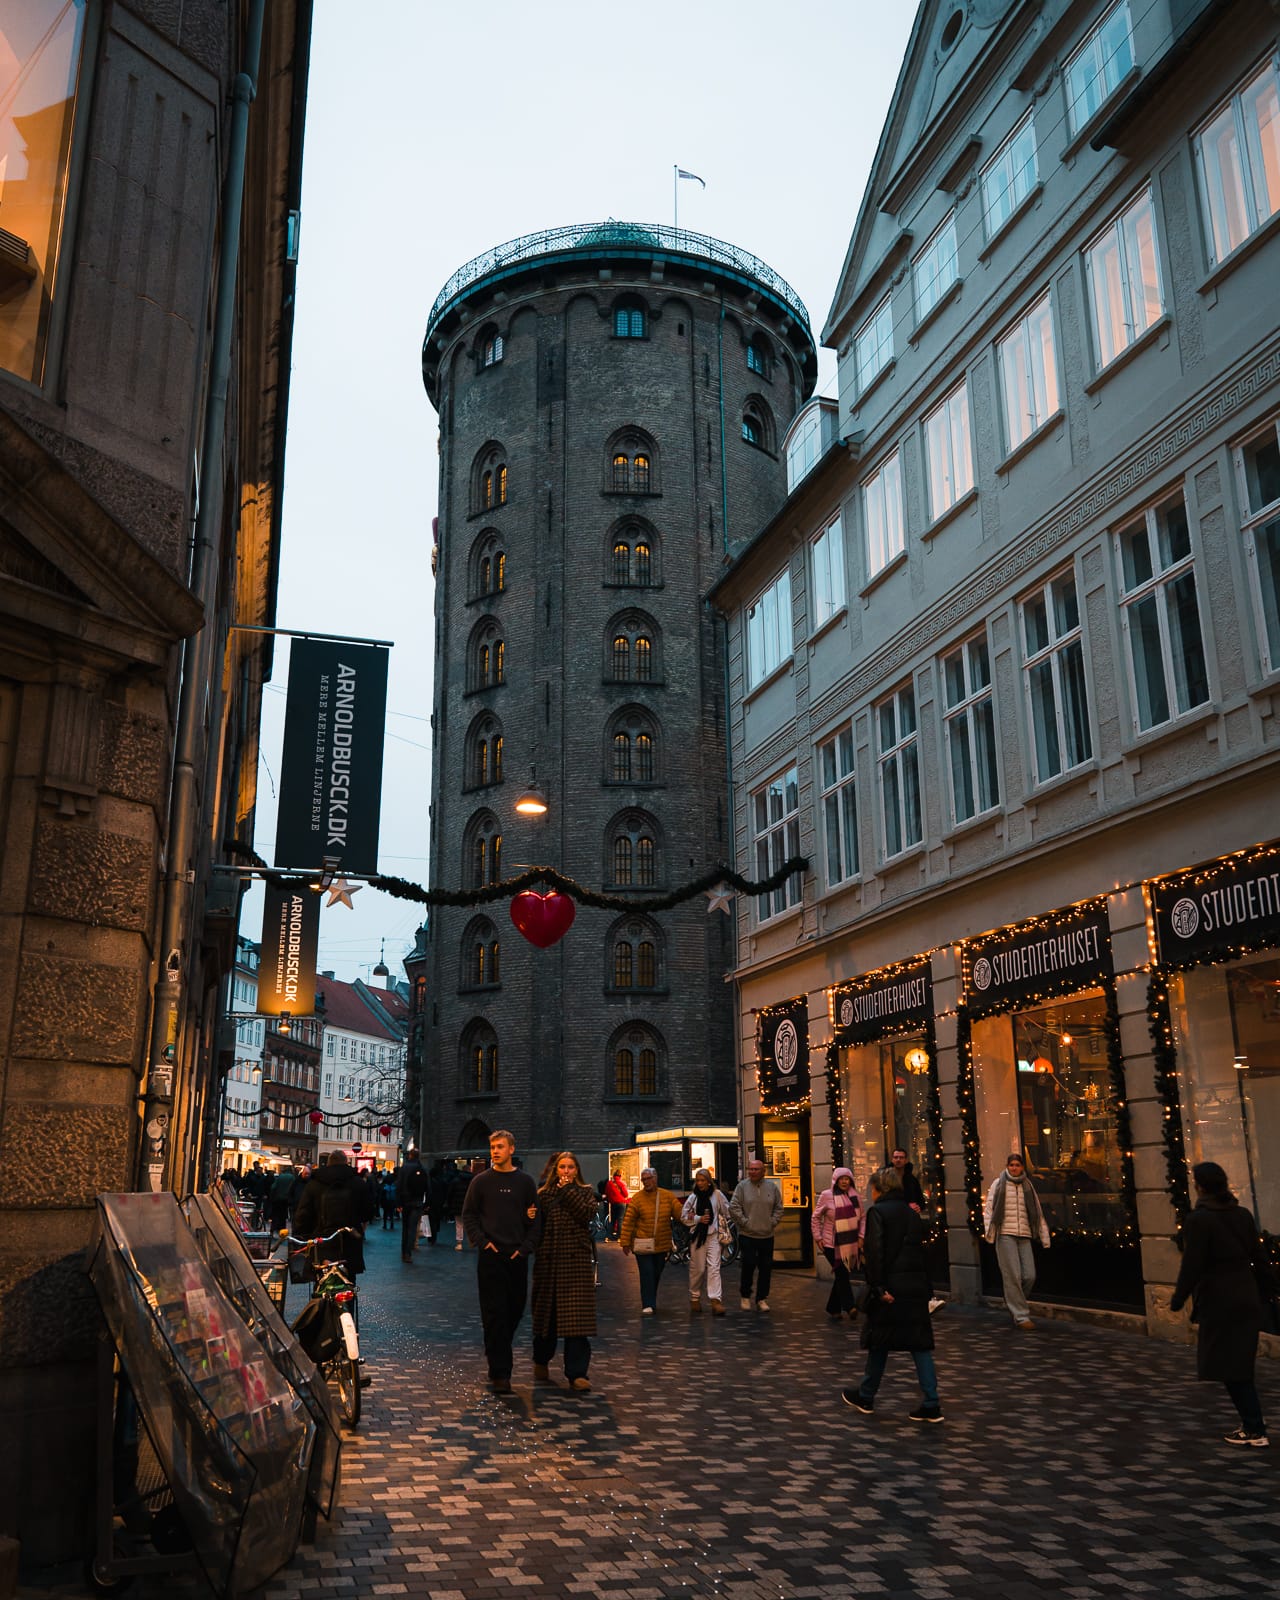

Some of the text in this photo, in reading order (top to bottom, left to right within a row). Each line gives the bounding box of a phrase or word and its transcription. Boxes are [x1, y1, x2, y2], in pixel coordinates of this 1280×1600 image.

[311, 674, 329, 832] MERE MELLEM LINJERNE
[327, 663, 356, 847] ARNOLDBUSCK.DK
[1200, 873, 1280, 932] STUDENT
[284, 895, 304, 1002] ARNOLDBUSCK.DK
[992, 925, 1100, 986] STUDENTERHUSET
[853, 977, 926, 1024] STUDENTERHUSET
